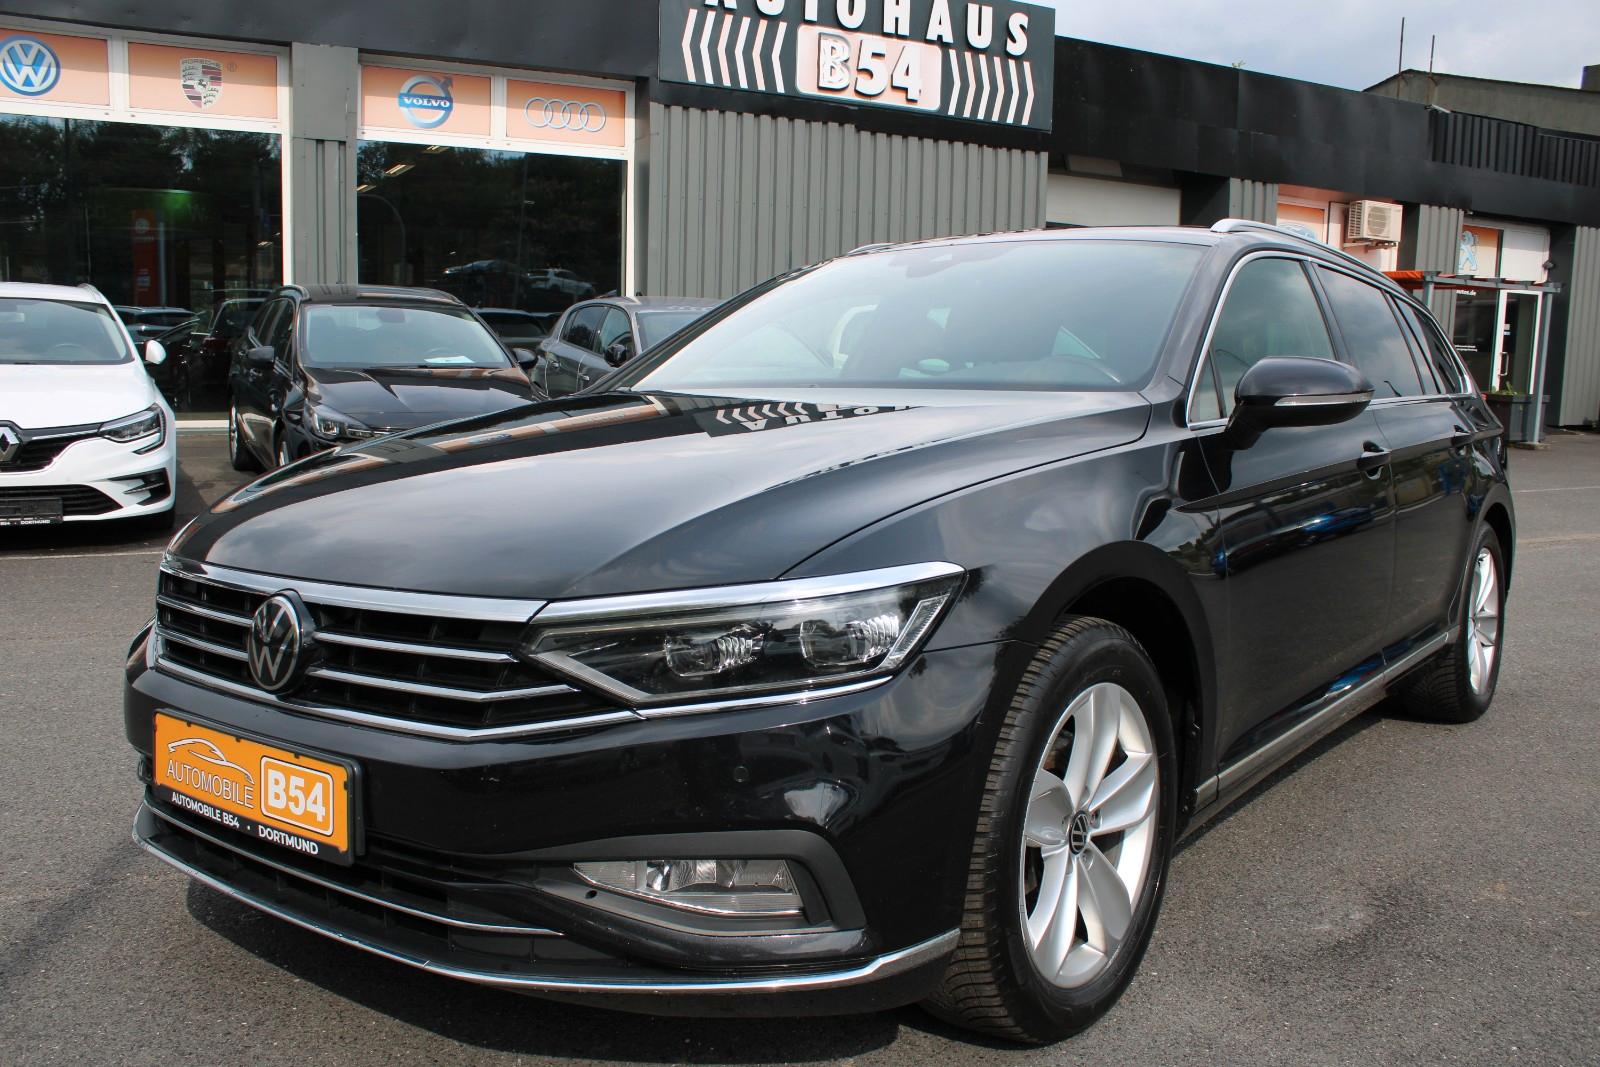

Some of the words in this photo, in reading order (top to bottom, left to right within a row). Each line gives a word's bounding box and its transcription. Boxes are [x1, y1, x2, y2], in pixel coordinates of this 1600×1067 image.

[704, 0, 1029, 56] OHAUS
[818, 32, 923, 102] B54
[402, 95, 450, 108] VOLVO
[166, 759, 255, 809] AUTOMOBILE
[267, 768, 326, 822] B54
[172, 791, 221, 822] AUTOMOBILE
[223, 811, 240, 829] B54
[258, 824, 319, 855] DORTMUND
